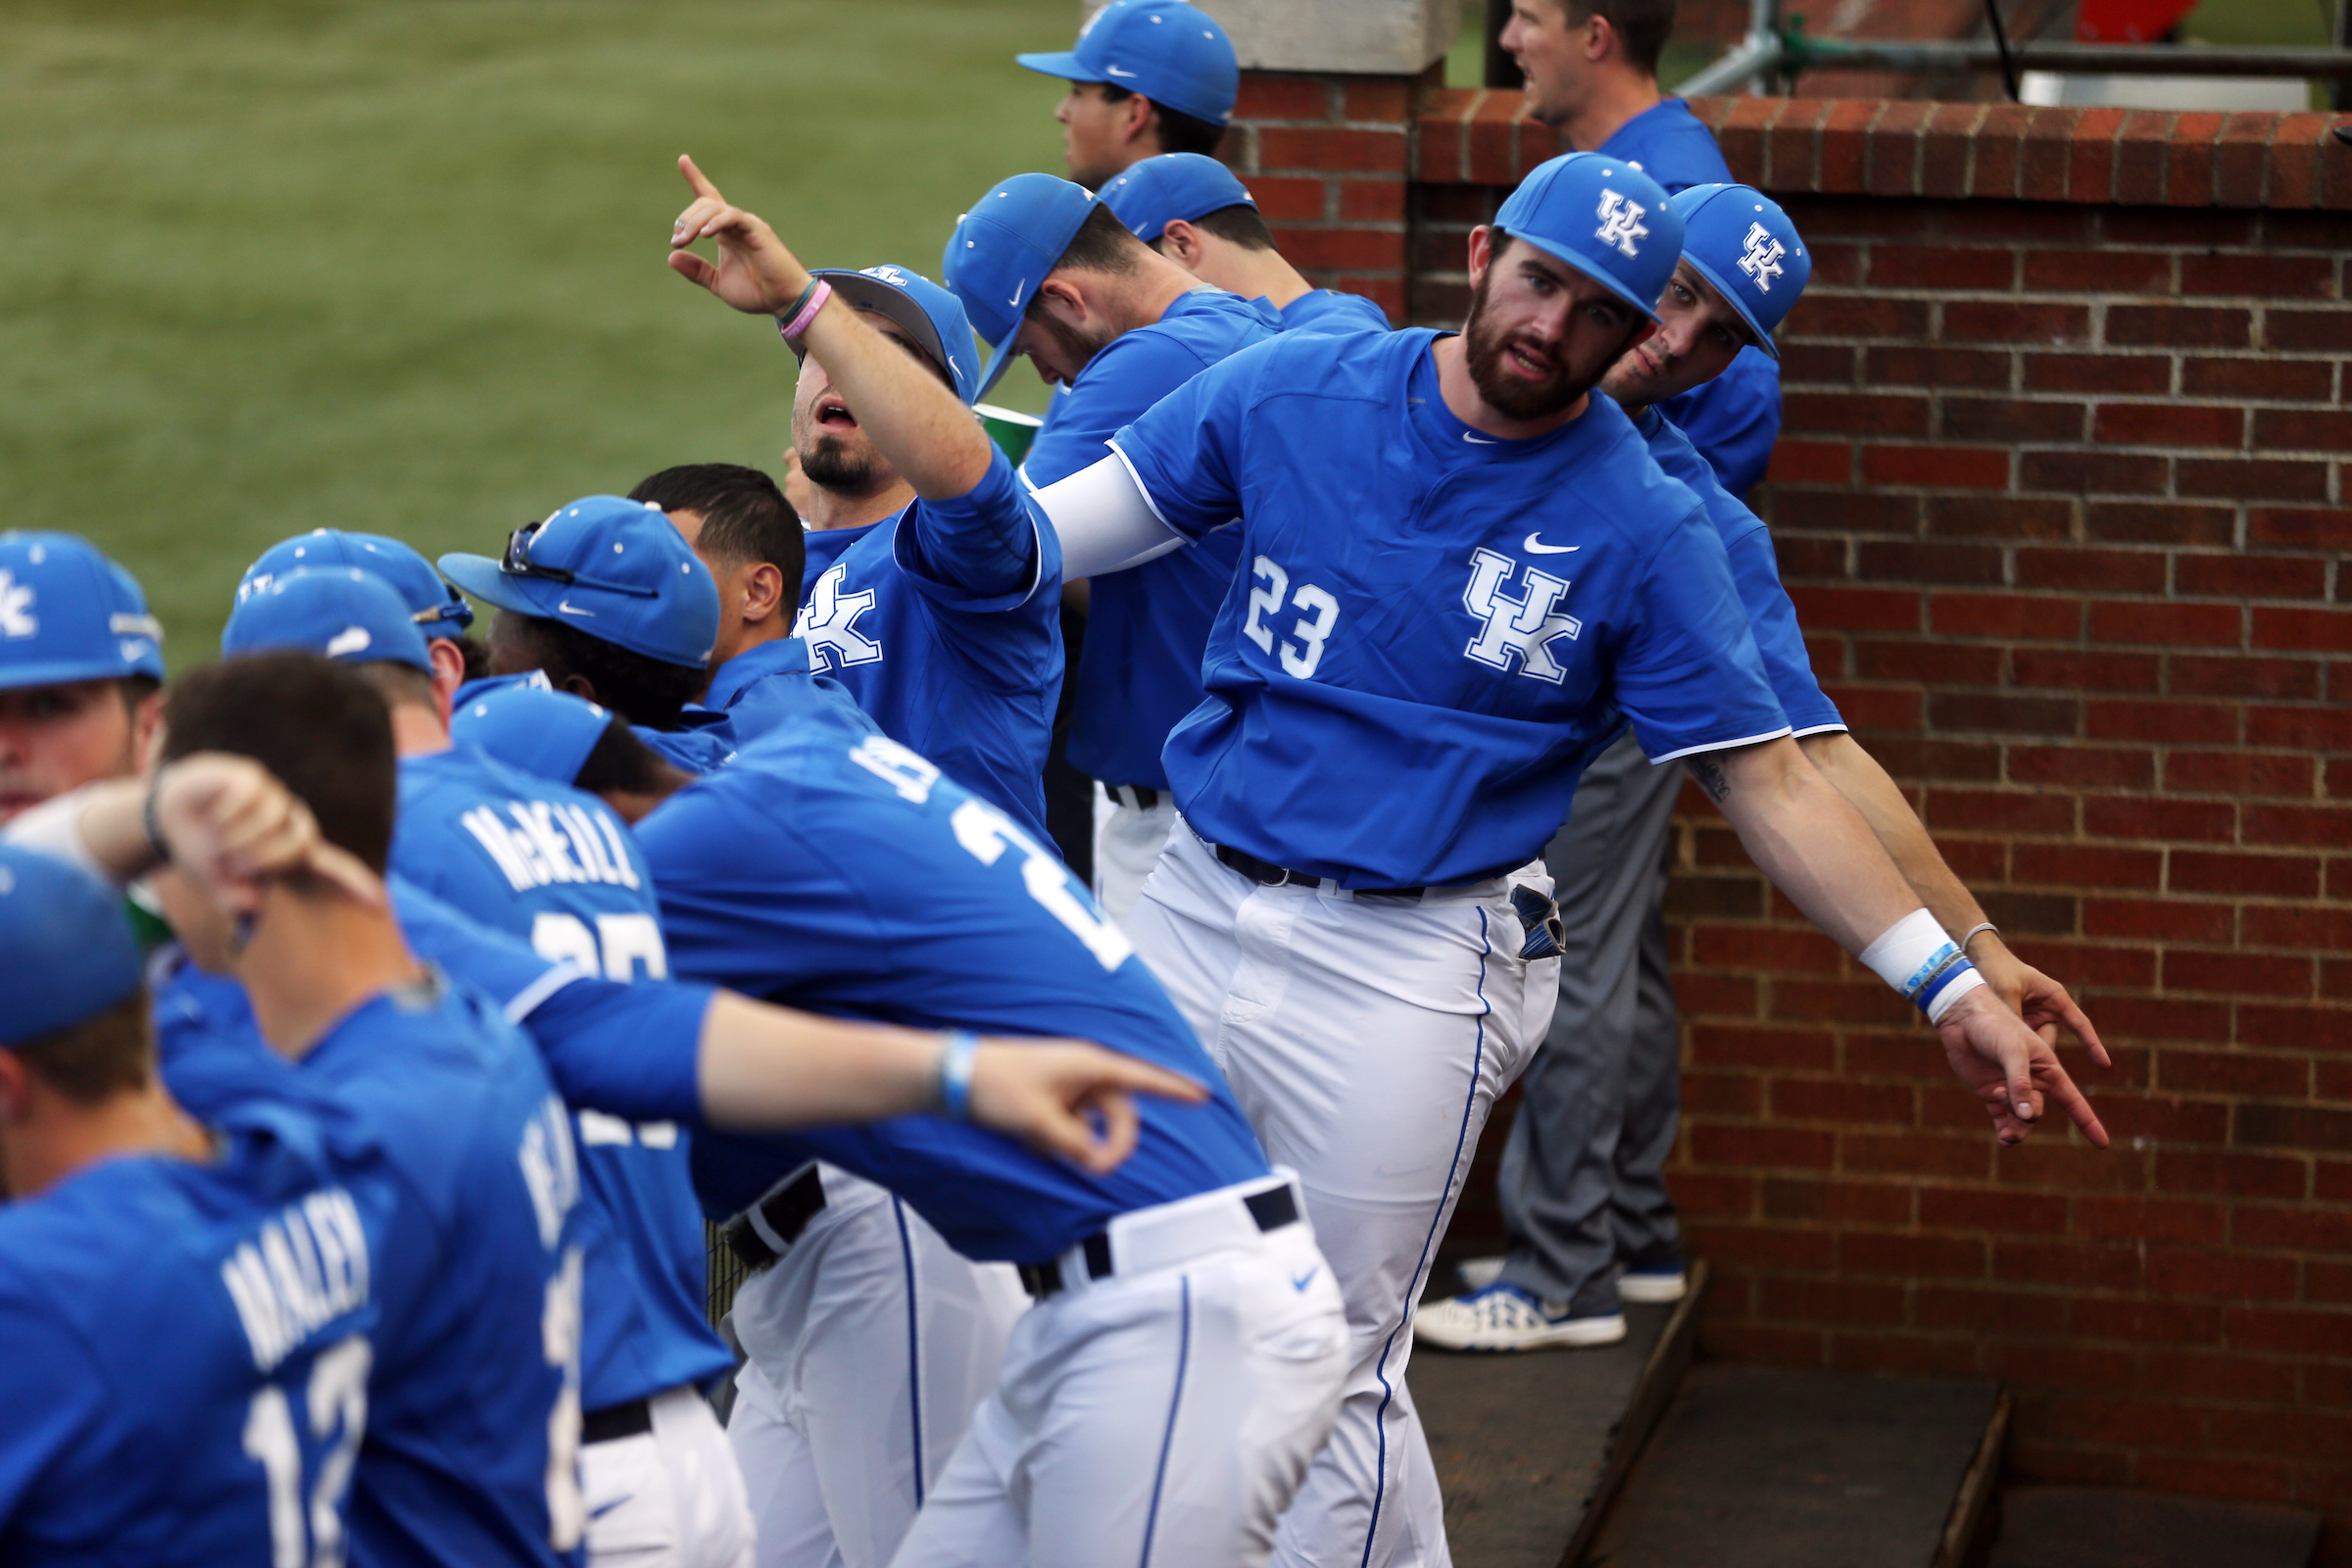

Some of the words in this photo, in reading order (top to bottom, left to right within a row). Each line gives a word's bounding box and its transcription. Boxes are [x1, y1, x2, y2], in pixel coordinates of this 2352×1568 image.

[1595, 189, 1649, 260] UK
[1737, 221, 1786, 294] UK
[1243, 555, 1340, 679] 23
[1464, 547, 1583, 685] UK
